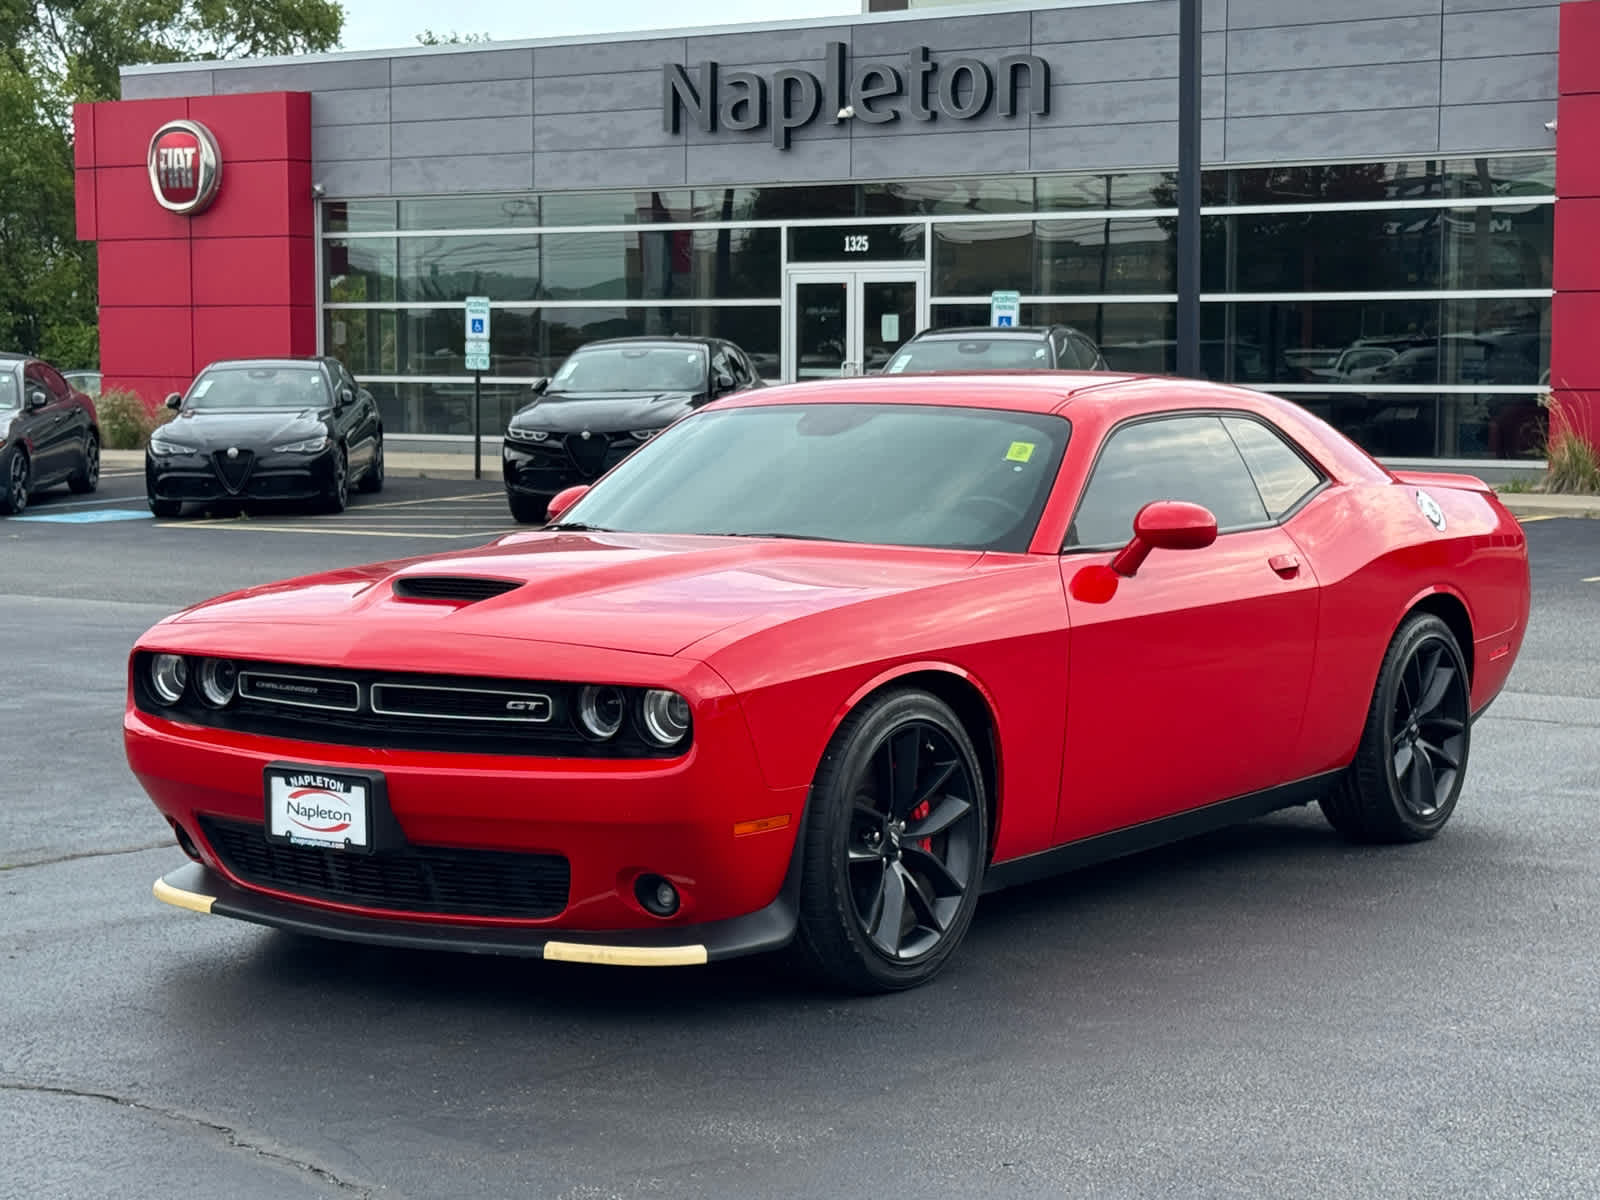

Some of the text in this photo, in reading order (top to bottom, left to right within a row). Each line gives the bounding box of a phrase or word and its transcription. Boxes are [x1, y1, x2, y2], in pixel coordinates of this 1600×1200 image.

[663, 41, 1051, 150] Napleton
[159, 146, 197, 189] FIAT
[844, 235, 869, 252] 1325
[506, 700, 545, 711] GT
[289, 775, 344, 793] NAPLETON
[286, 800, 352, 823] Napleton
